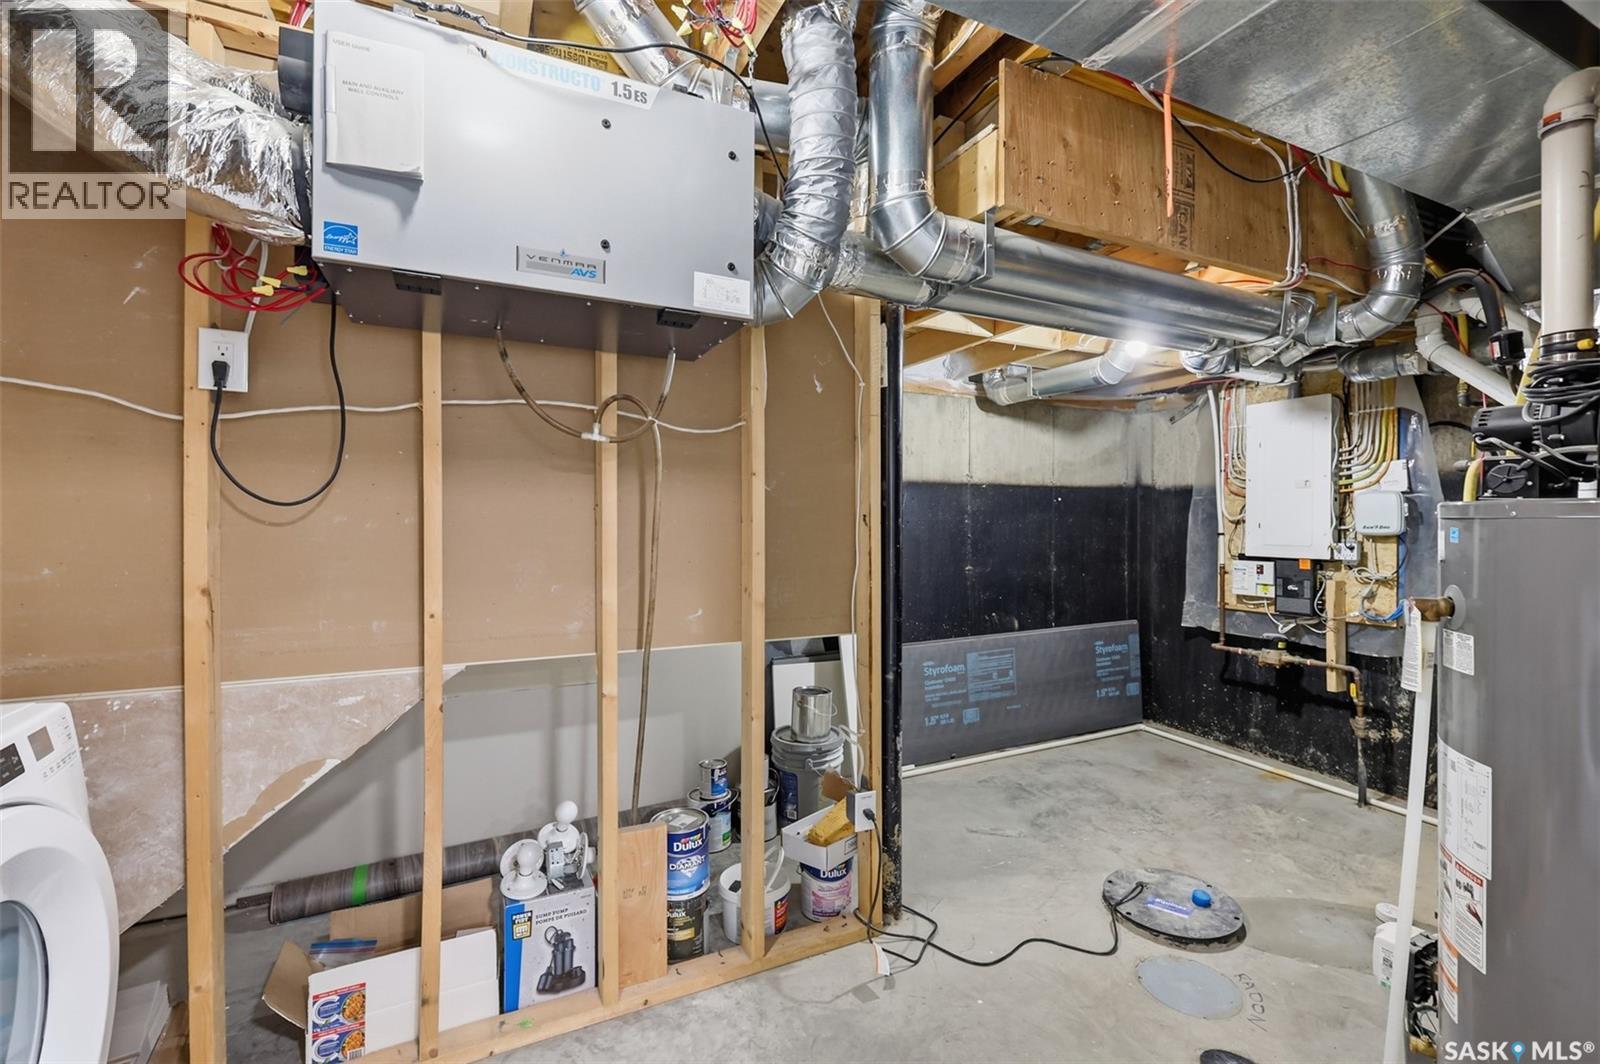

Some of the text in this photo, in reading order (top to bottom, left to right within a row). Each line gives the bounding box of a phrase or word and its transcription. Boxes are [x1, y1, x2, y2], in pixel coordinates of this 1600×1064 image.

[611, 81, 632, 100] 1.5
[634, 90, 648, 104] ES
[526, 253, 597, 269] VENMAR
[571, 268, 597, 279] AVS
[1095, 642, 1128, 655] Styrofoam
[923, 663, 965, 677] Styrofoam
[673, 838, 703, 852] Dulux
[820, 867, 847, 879] Dulux
[535, 908, 569, 919] SUMP PUMP
